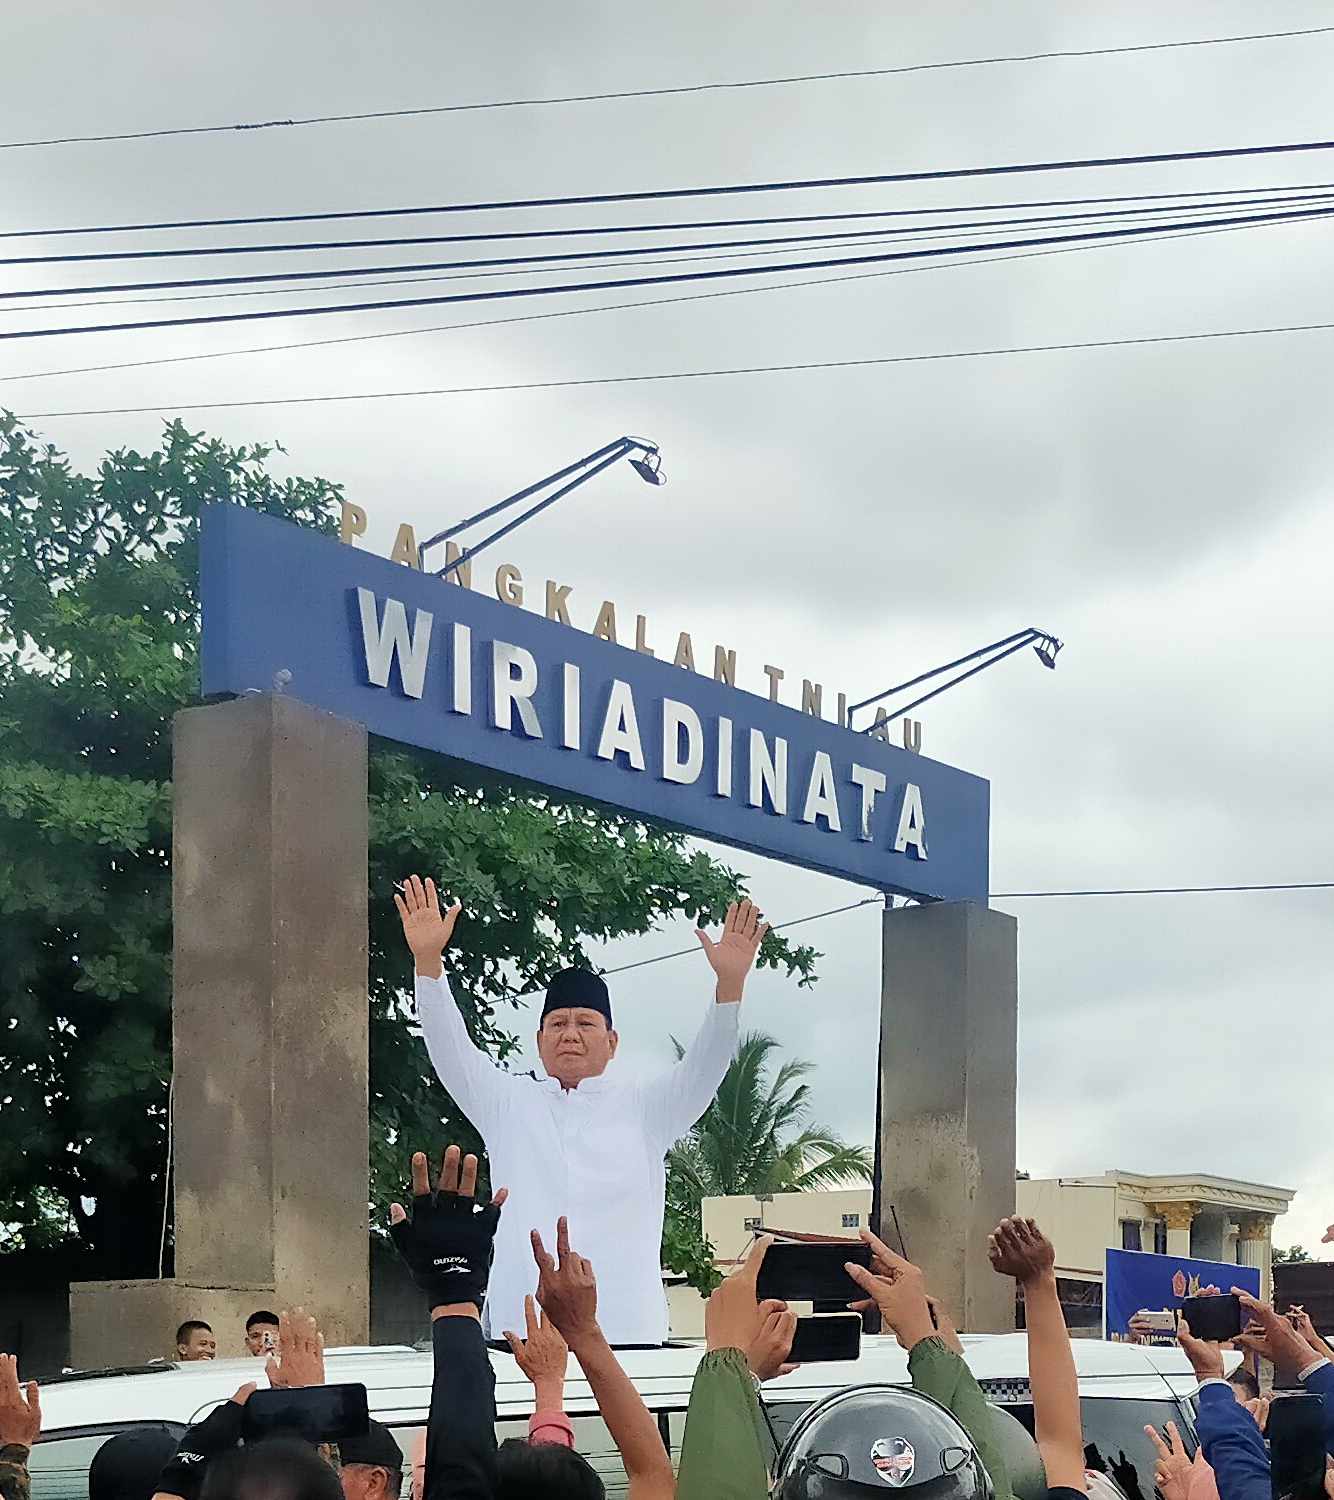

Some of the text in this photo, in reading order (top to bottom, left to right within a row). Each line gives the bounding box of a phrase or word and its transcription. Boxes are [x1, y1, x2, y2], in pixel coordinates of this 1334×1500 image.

[340, 498, 923, 754] PANGKALAN TNI AU
[355, 585, 930, 862] WIRIADINATA
